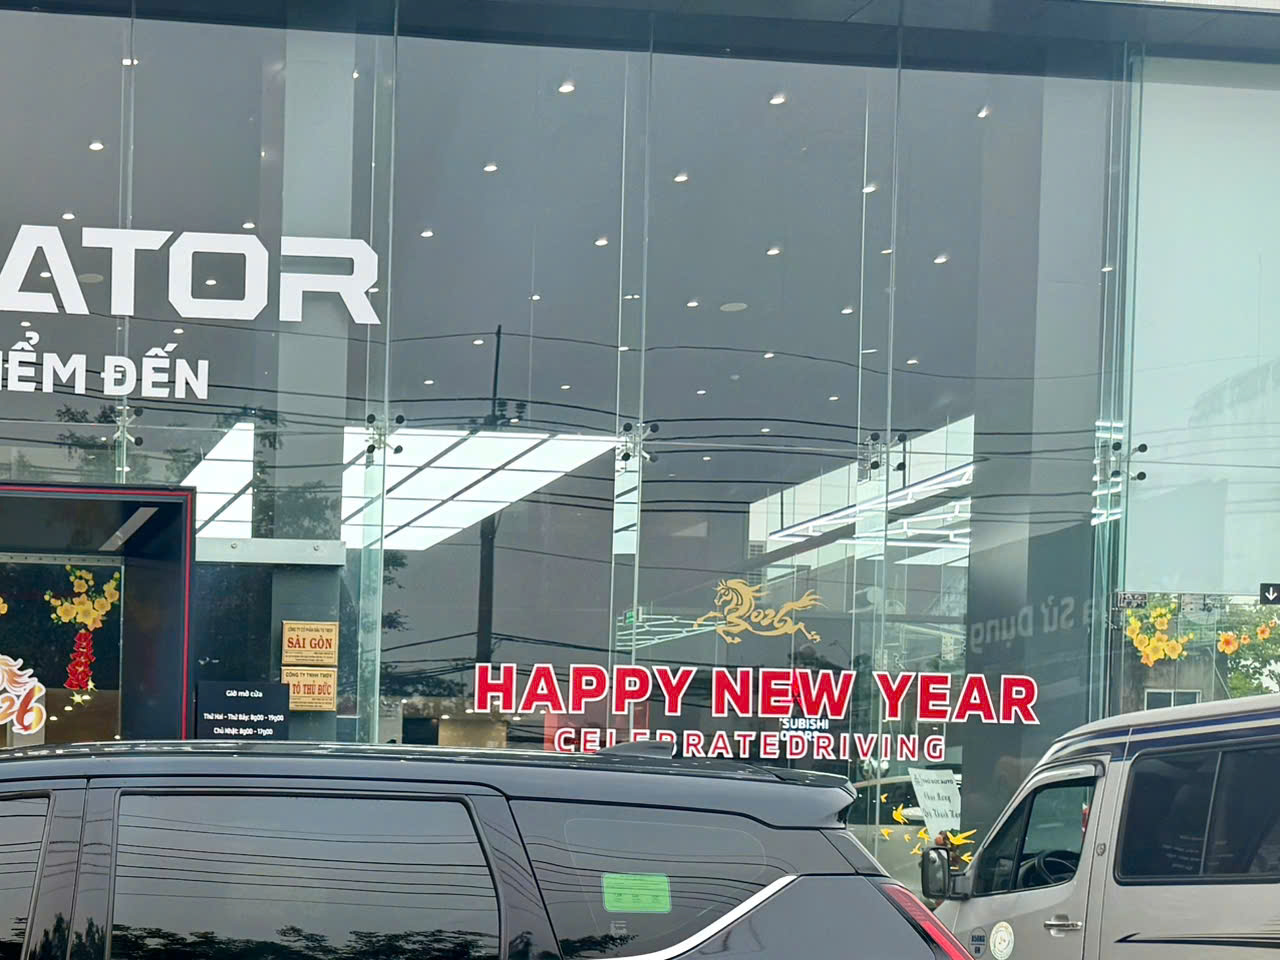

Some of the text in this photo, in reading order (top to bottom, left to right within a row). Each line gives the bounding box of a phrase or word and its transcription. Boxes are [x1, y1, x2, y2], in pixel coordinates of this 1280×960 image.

[100, 343, 210, 400] ĐẾN
[287, 634, 333, 649] SÀI GÒN
[474, 663, 1040, 724] HAPPY NEW YEAR
[779, 717, 829, 729] SUBISHI
